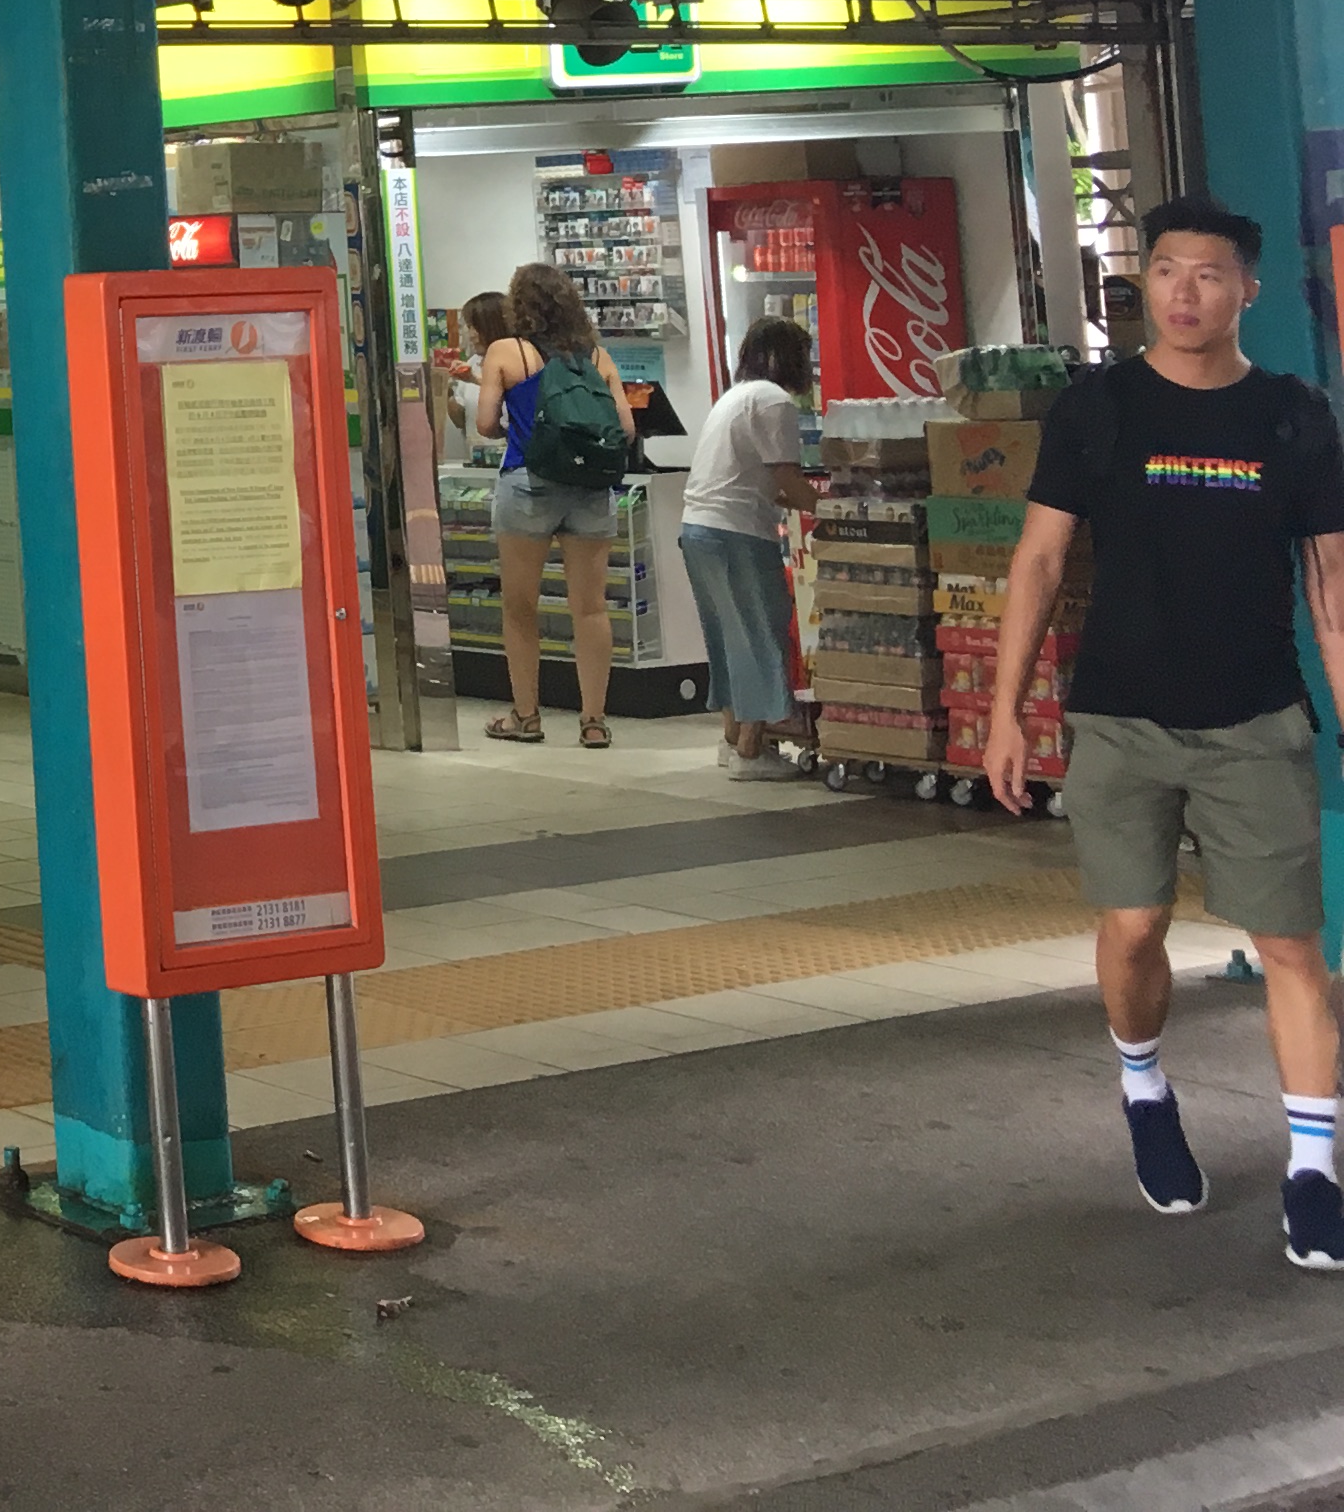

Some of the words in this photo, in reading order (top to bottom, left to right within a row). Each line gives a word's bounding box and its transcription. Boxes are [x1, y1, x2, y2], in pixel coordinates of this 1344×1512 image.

[392, 176, 411, 238] 本店不設
[398, 242, 414, 288] 八達通
[400, 293, 419, 356] 增值服務
[176, 328, 223, 345] 新渡輪
[949, 594, 985, 613] Max
[257, 902, 280, 917] 2131
[258, 917, 281, 931] 2131
[283, 913, 306, 927] 8877
